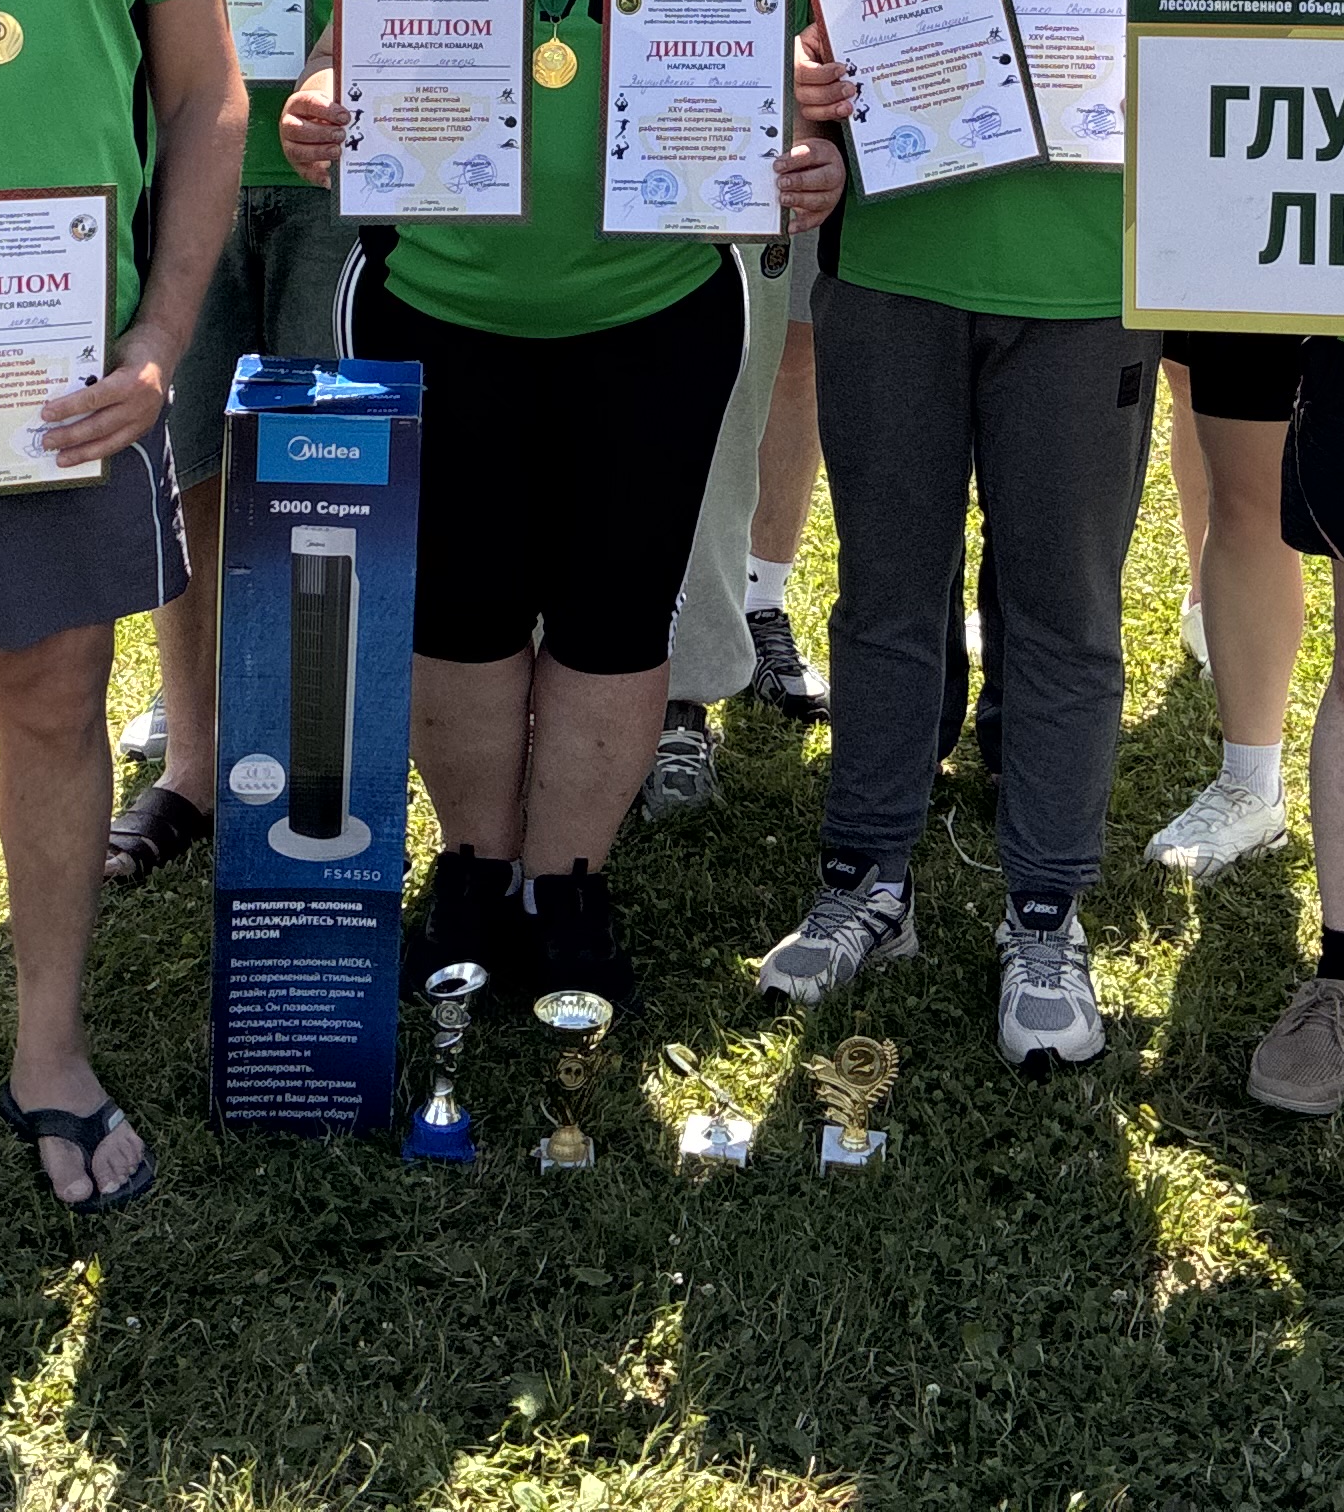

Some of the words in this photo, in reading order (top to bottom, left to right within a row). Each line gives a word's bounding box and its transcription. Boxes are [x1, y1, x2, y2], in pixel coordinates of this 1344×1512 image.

[885, 4, 943, 24] НАГРАЖДАЕТСЯ
[380, 19, 493, 40] ДИПЛОМ
[382, 42, 443, 50] НАГРАЖДАЕТСЯ
[646, 41, 754, 62] ДИПЛОМ
[16, 299, 61, 309] КОМАНДА
[287, 436, 360, 461] Midea
[269, 500, 312, 514] 3000
[316, 501, 370, 518] Серия
[324, 869, 381, 881] FS4550
[233, 900, 305, 912] Вентилятор
[232, 914, 334, 927] НАСЛАЖДАЙТЕСЬ
[335, 916, 377, 928] ТИХИМ
[231, 929, 280, 940] БРИЗОМ
[231, 958, 291, 968] Вентилятор
[293, 959, 336, 967] колонна
[338, 958, 372, 968] MIDEA
[230, 974, 247, 983] это
[249, 972, 321, 983] современный
[322, 973, 372, 983] стильный
[229, 988, 267, 1000] дизайн
[267, 989, 287, 998] для
[289, 987, 327, 997] Вашего
[328, 989, 356, 998] дома
[356, 990, 364, 998] и
[265, 1002, 280, 1011] Он
[282, 1004, 336, 1012] позволяет
[228, 1020, 300, 1028] наслаждаться
[228, 1032, 273, 1044] который
[275, 1032, 290, 1042] Вы
[318, 1035, 358, 1043] можете
[227, 1050, 303, 1060] устанавливать
[849, 1048, 875, 1076] 2
[227, 1078, 303, 1089] Многообразие
[304, 1080, 357, 1089] программ
[226, 1094, 275, 1105] принесет
[285, 1093, 306, 1102] Ваш
[307, 1095, 329, 1103] дом
[226, 1110, 267, 1119] ветерок
